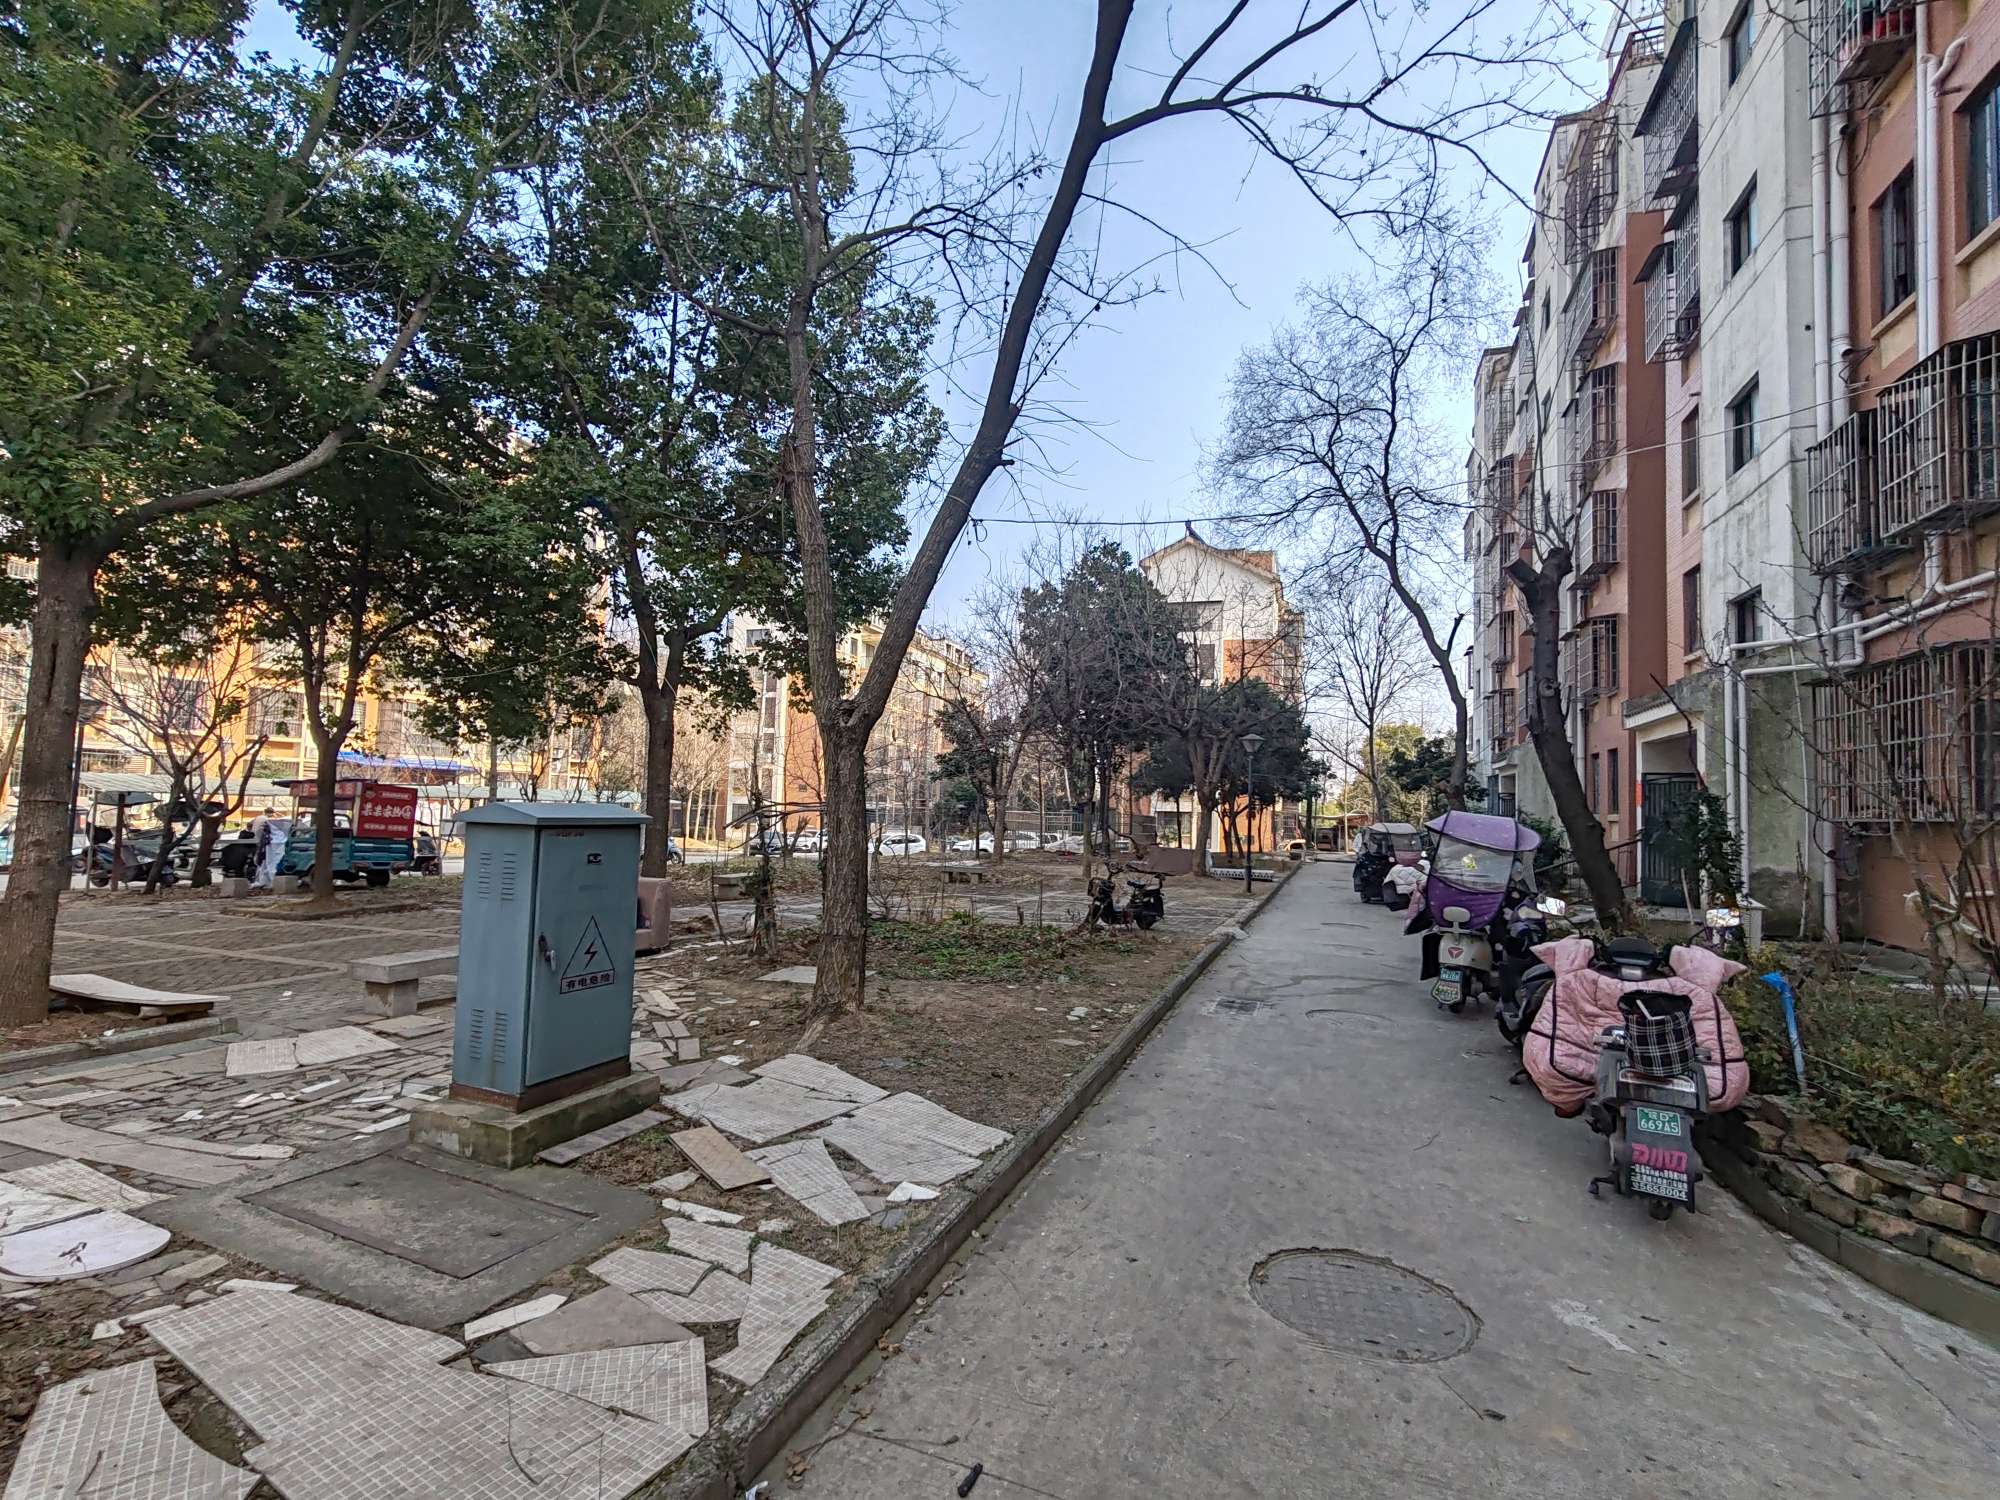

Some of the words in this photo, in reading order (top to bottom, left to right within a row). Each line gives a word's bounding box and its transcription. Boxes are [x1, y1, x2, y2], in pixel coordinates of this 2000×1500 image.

[566, 972, 610, 990] 有电危险
[1640, 1119, 1679, 1133] 669A5
